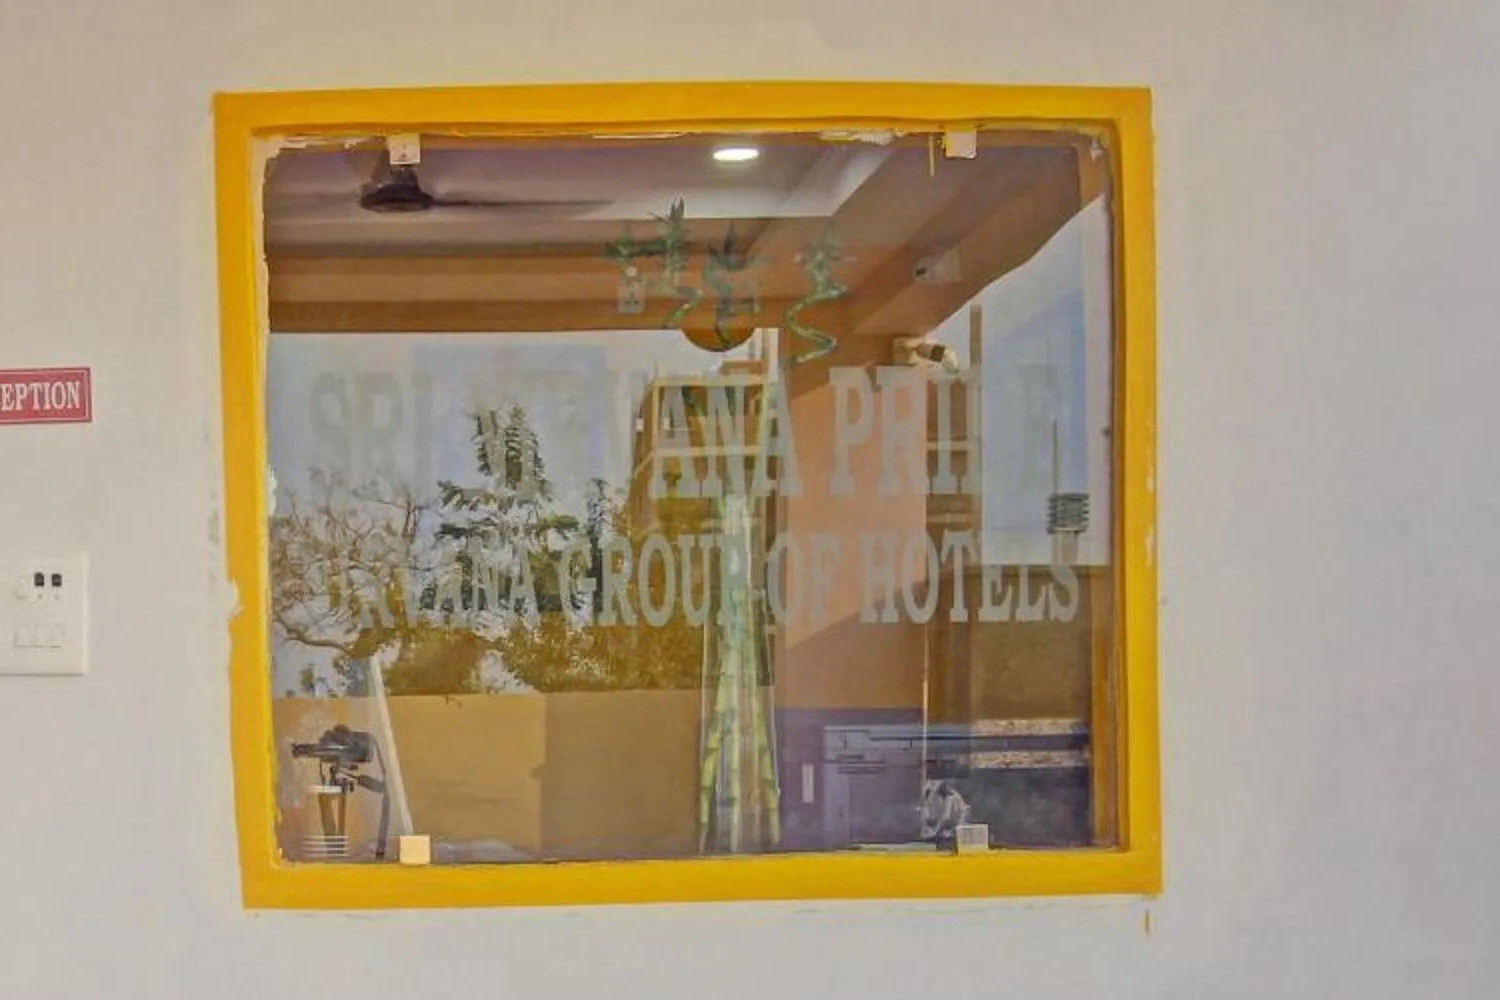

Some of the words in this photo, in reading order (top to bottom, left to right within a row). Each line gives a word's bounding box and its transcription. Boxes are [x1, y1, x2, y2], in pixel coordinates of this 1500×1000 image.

[828, 364, 1070, 499] PRIE
[288, 533, 543, 628] RVANA
[767, 530, 839, 626] OF
[858, 528, 1081, 625] HOTELS
